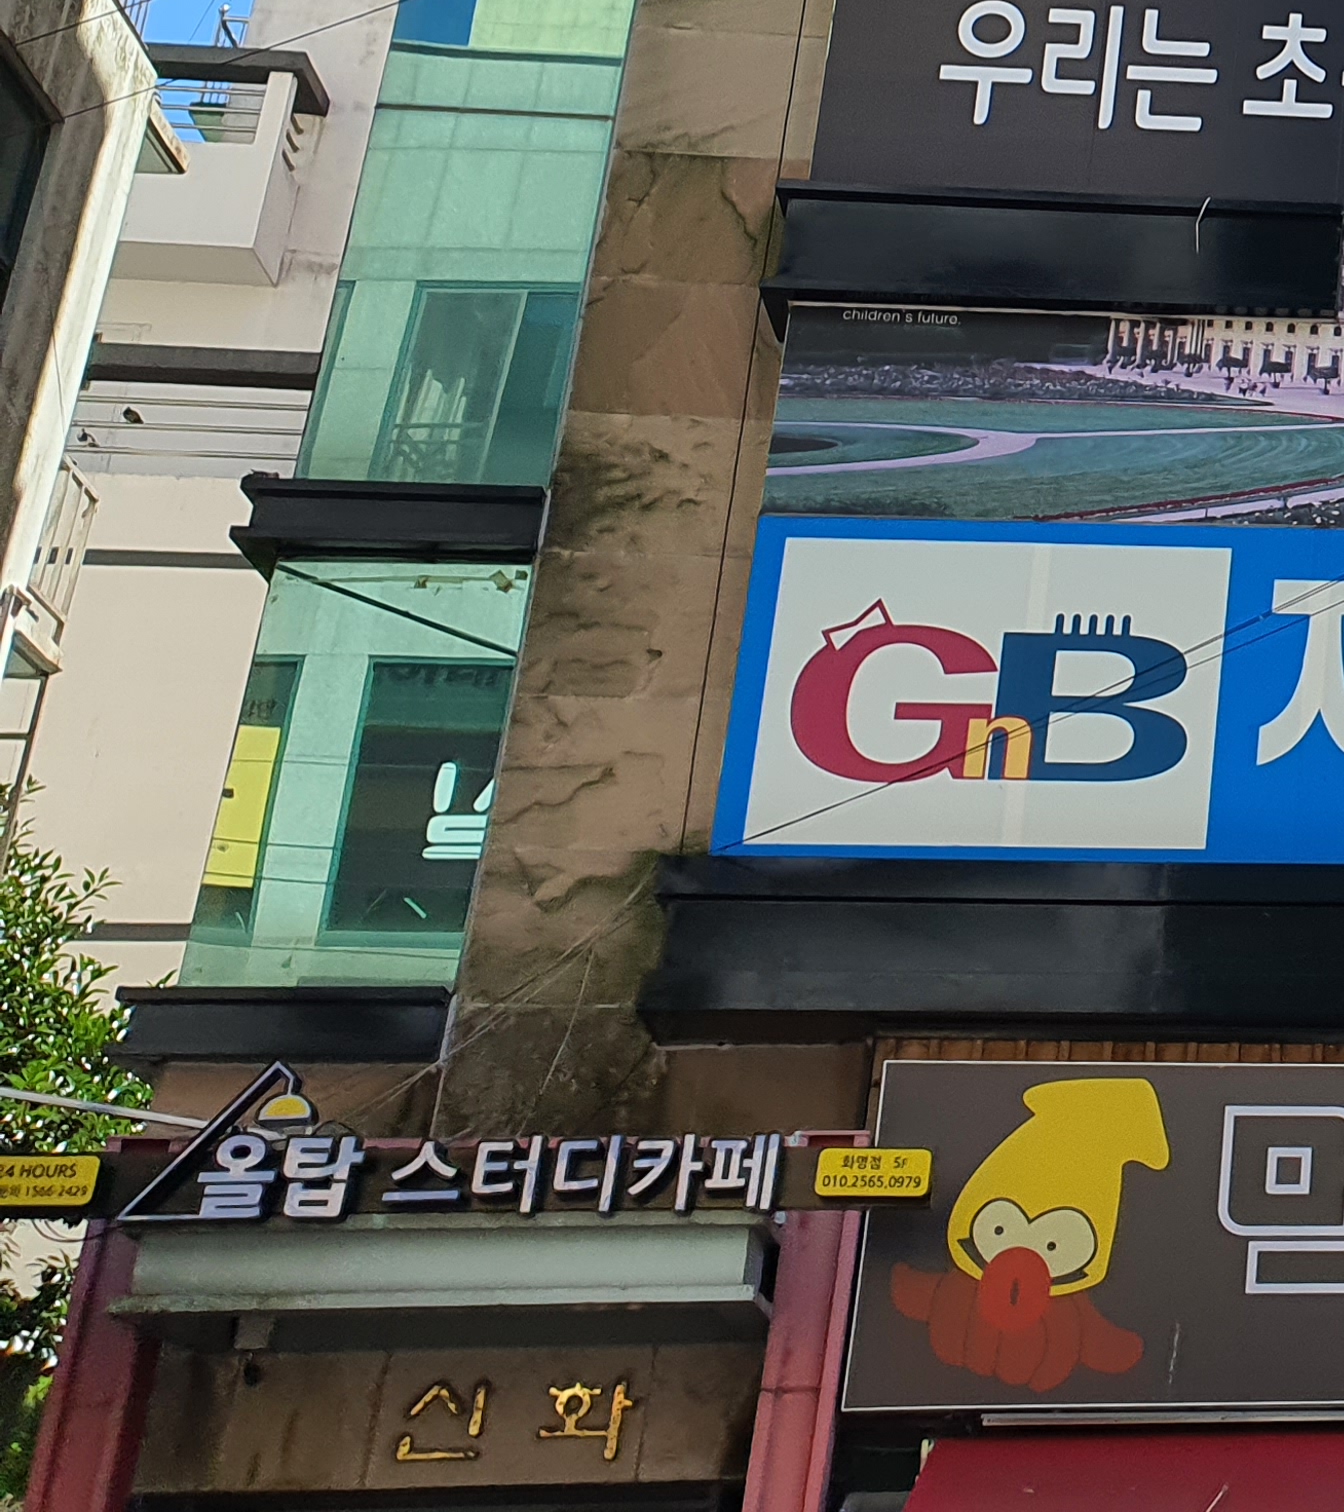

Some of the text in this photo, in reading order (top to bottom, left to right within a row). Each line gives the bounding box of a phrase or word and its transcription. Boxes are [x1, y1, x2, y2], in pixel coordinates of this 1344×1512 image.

[939, 0, 1219, 132] 우리는
[19, 1163, 77, 1179] HOURS
[197, 1132, 782, 1219] 올탑 스터디카페
